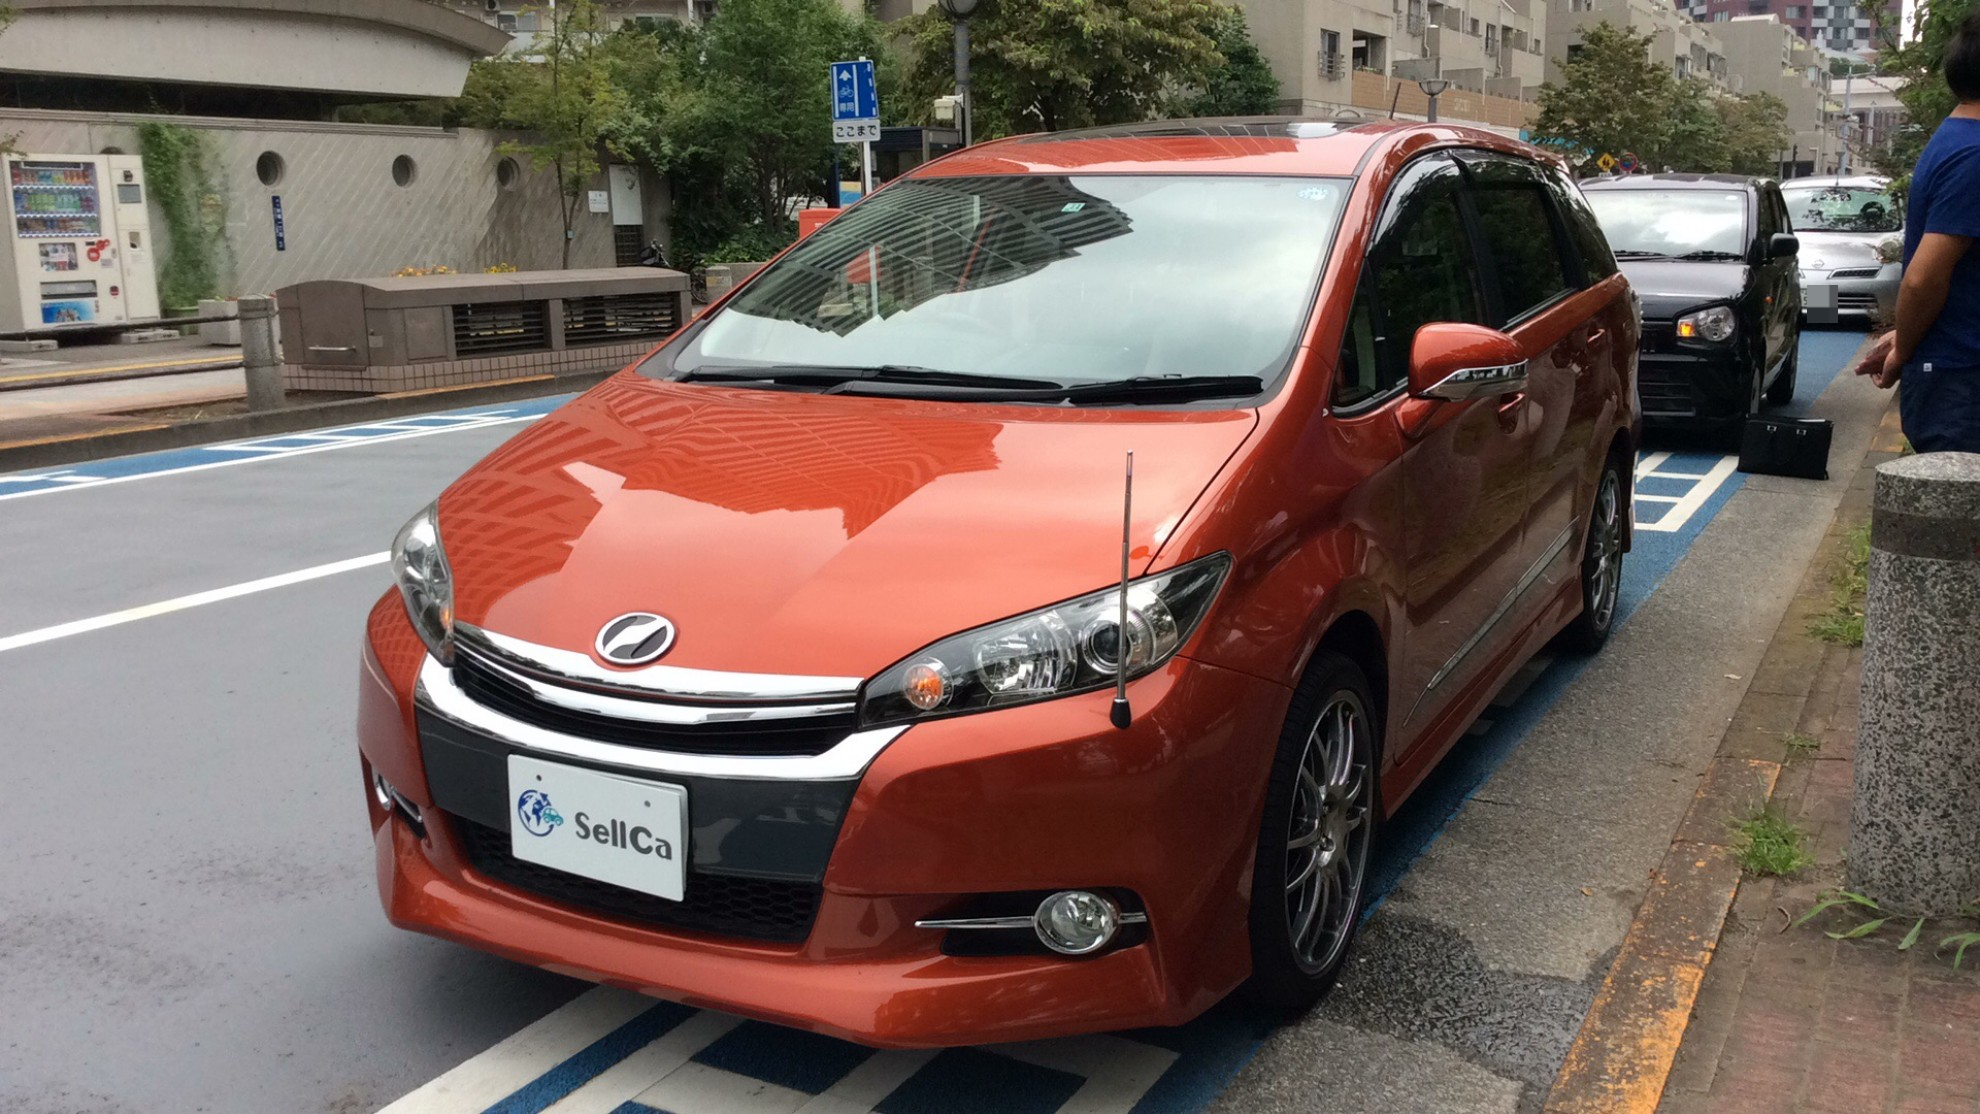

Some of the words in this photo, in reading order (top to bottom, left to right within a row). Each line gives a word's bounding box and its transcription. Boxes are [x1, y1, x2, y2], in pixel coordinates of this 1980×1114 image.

[836, 125, 877, 138] ここまで
[574, 811, 673, 861] SellCa
